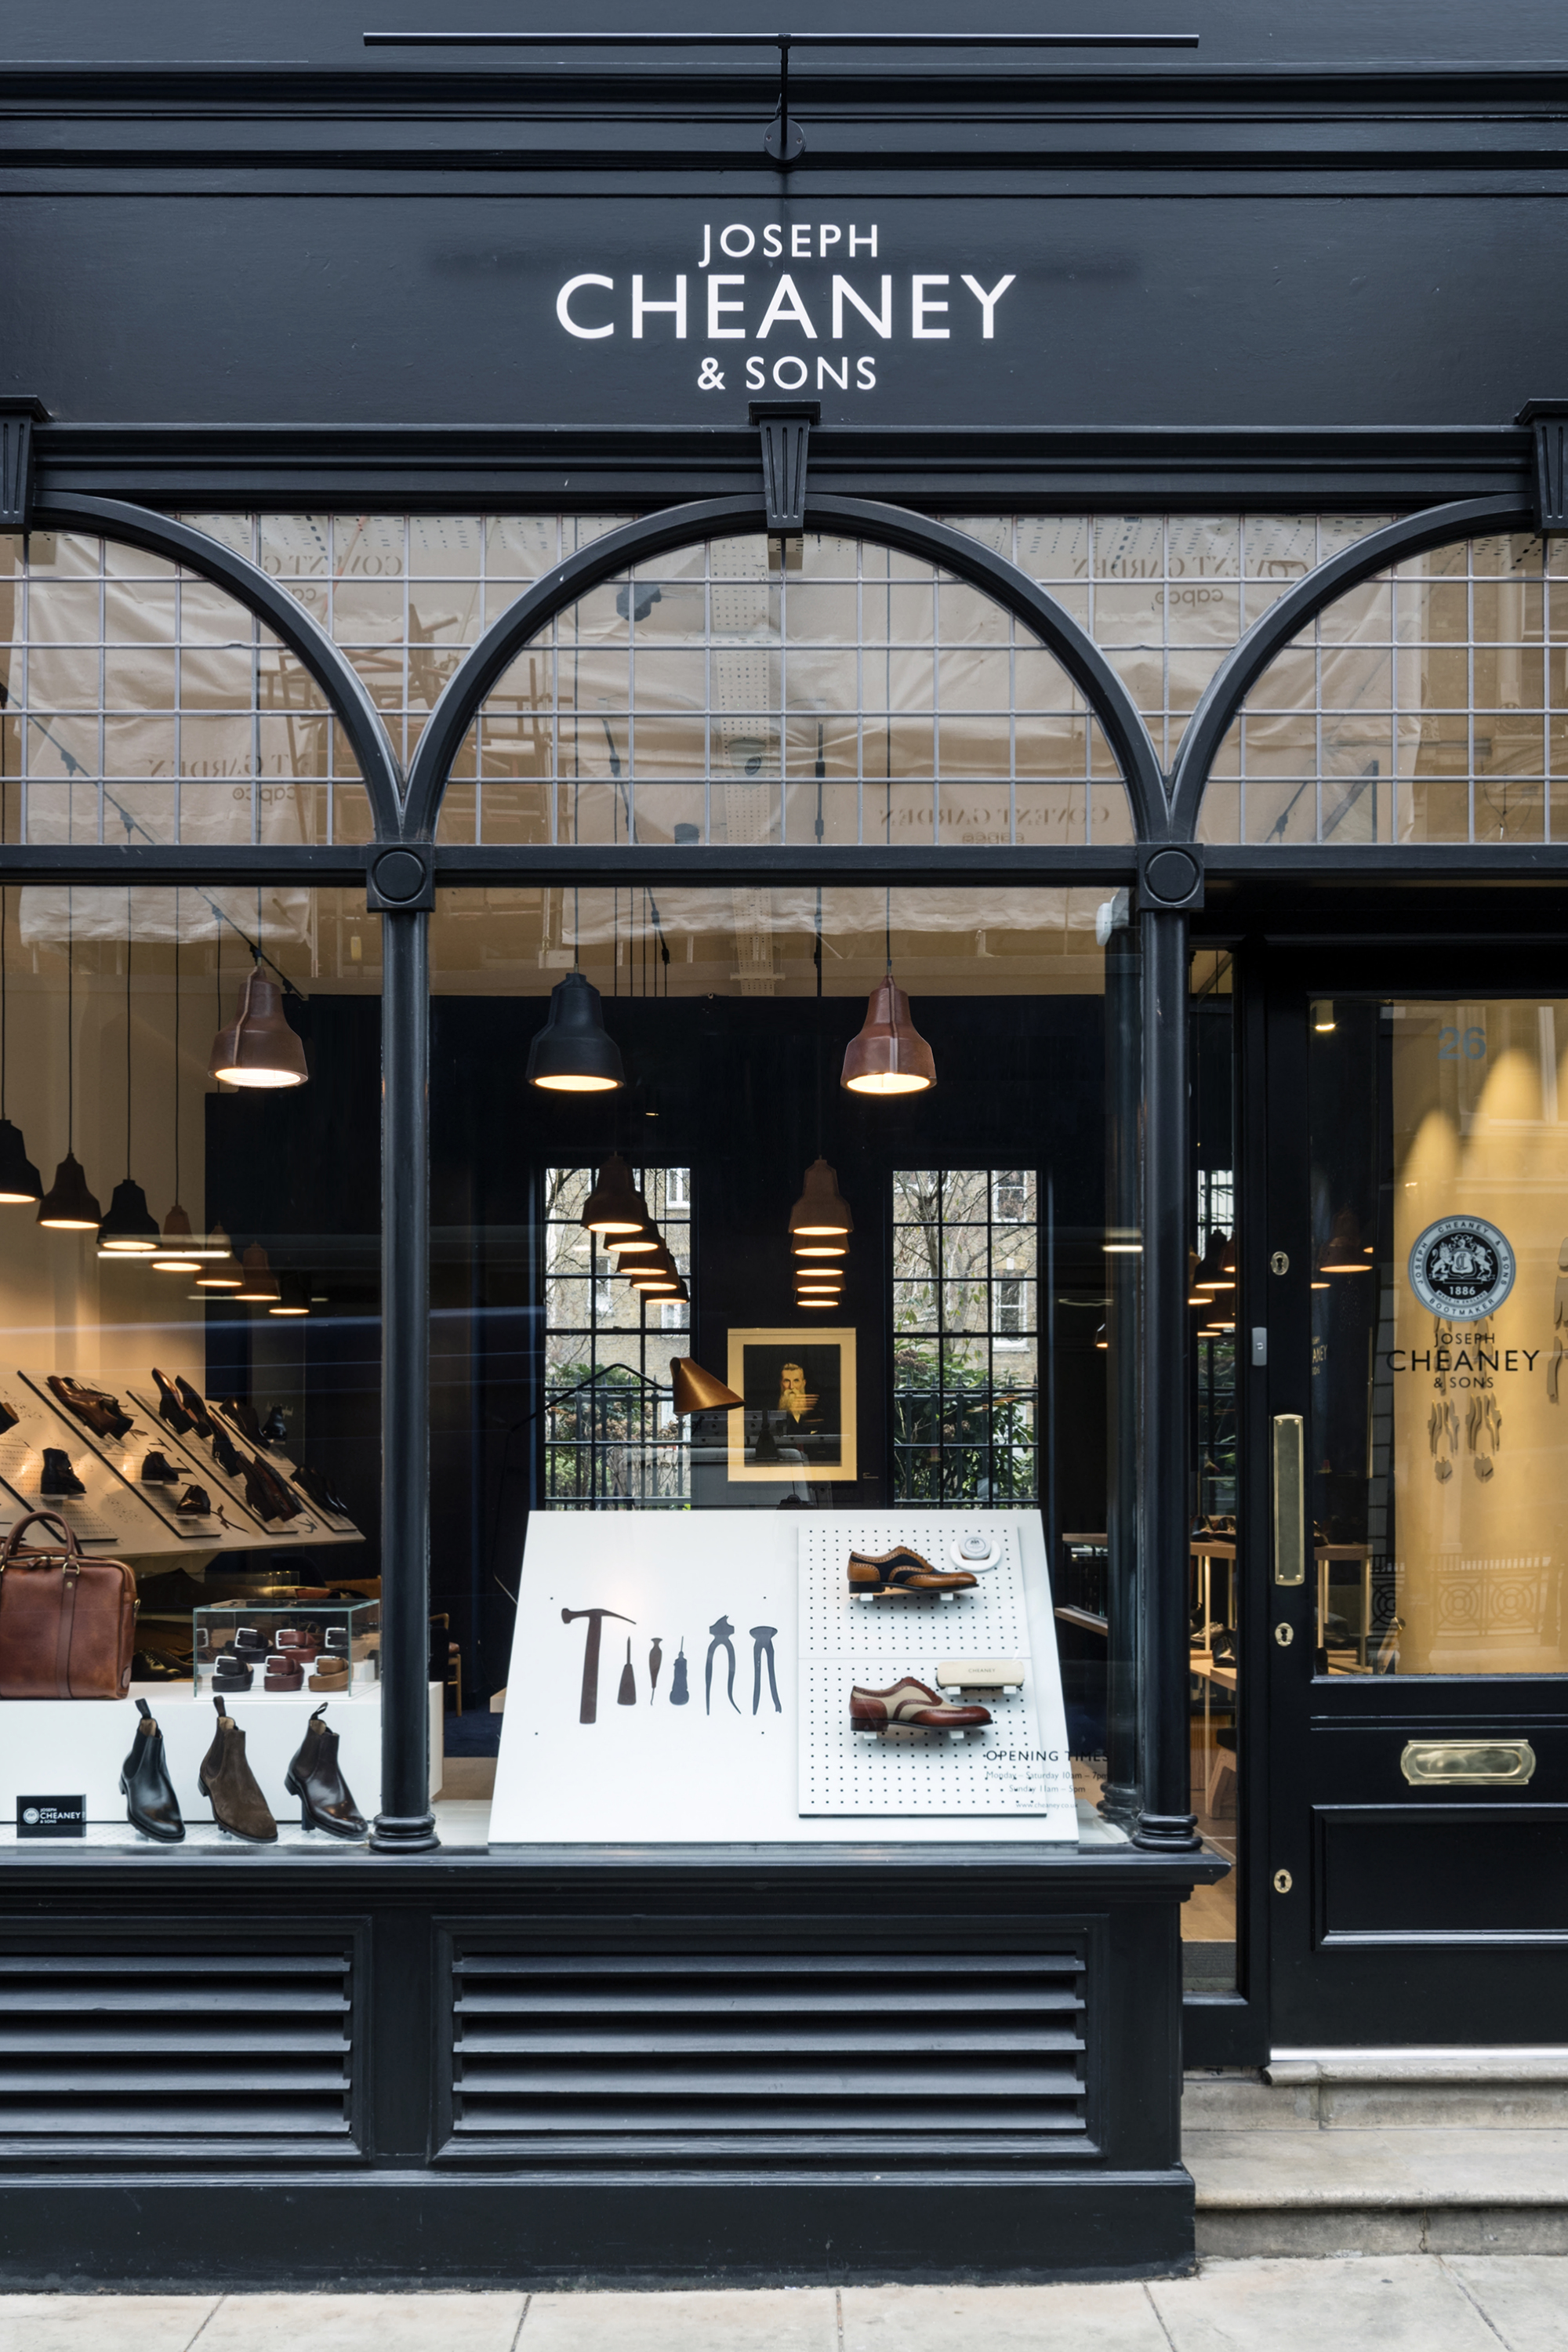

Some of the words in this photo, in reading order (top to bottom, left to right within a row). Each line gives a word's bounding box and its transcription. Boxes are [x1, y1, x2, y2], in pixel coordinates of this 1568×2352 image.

[698, 223, 879, 269] JOSEPH
[555, 273, 1017, 340] CHEANEY
[696, 357, 726, 391] &
[746, 356, 878, 390] SONS
[1438, 1026, 1486, 1061] 26
[1415, 1242, 1428, 1285] JOSEPH
[1438, 1221, 1490, 1234] CHEANEY
[1501, 1256, 1510, 1285] SONS
[1449, 1286, 1475, 1296] 1886
[1429, 1298, 1494, 1316] BOOTMAKER
[1434, 1333, 1495, 1348] JOSEPH
[1386, 1350, 1541, 1372] CHEANEY
[1433, 1377, 1443, 1388] &
[1450, 1377, 1494, 1388] SONS
[985, 1750, 1059, 1762] OPENING
[1064, 1751, 1111, 1762] TIMES
[986, 1771, 1018, 1780] Monday
[1025, 1771, 1059, 1780] Saturday
[1062, 1771, 1083, 1780] 10am
[1009, 1784, 1036, 1795] Sunday
[1069, 1785, 1086, 1795] 5pm
